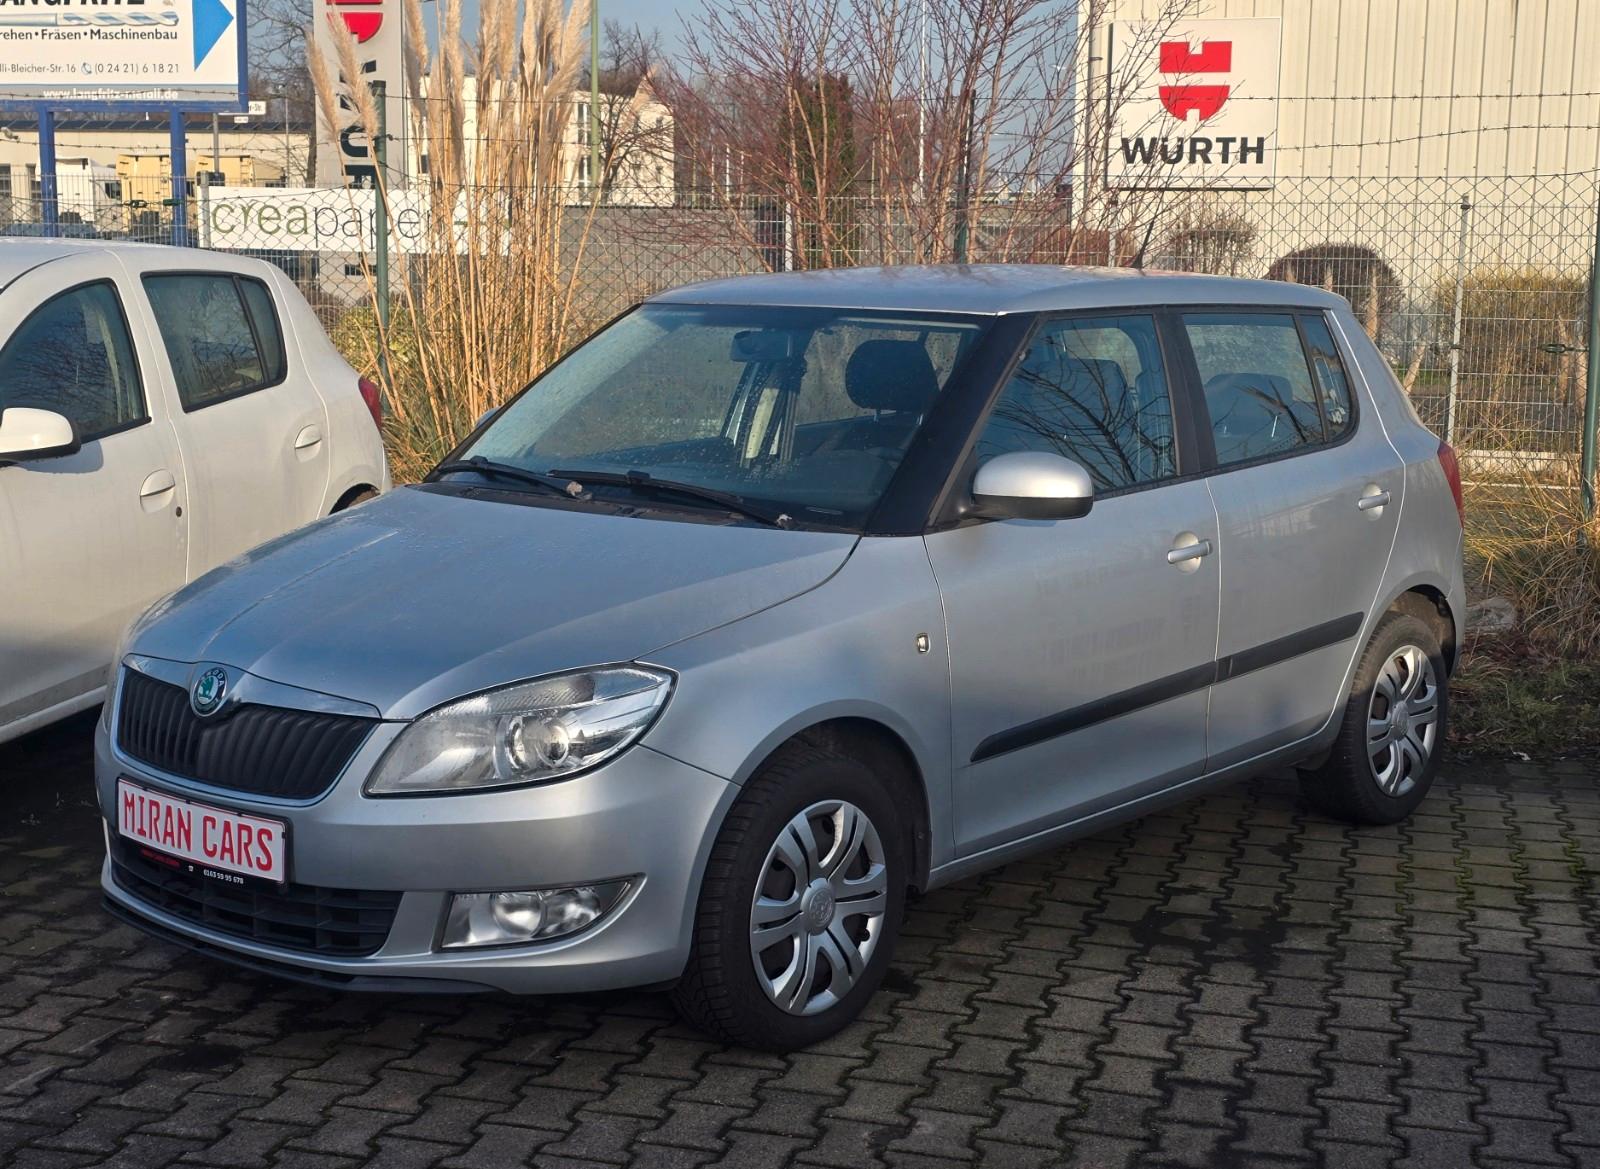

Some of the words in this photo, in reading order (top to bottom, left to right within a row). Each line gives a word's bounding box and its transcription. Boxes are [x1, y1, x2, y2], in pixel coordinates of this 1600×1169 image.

[0, 28, 33, 40] ehen
[41, 28, 82, 40] Fräsen
[90, 28, 178, 40] Maschinenbau
[66, 63, 76, 73] 16
[1120, 136, 1266, 165] WÜRTH
[123, 789, 192, 852] MIRAN
[202, 815, 273, 872] CARS
